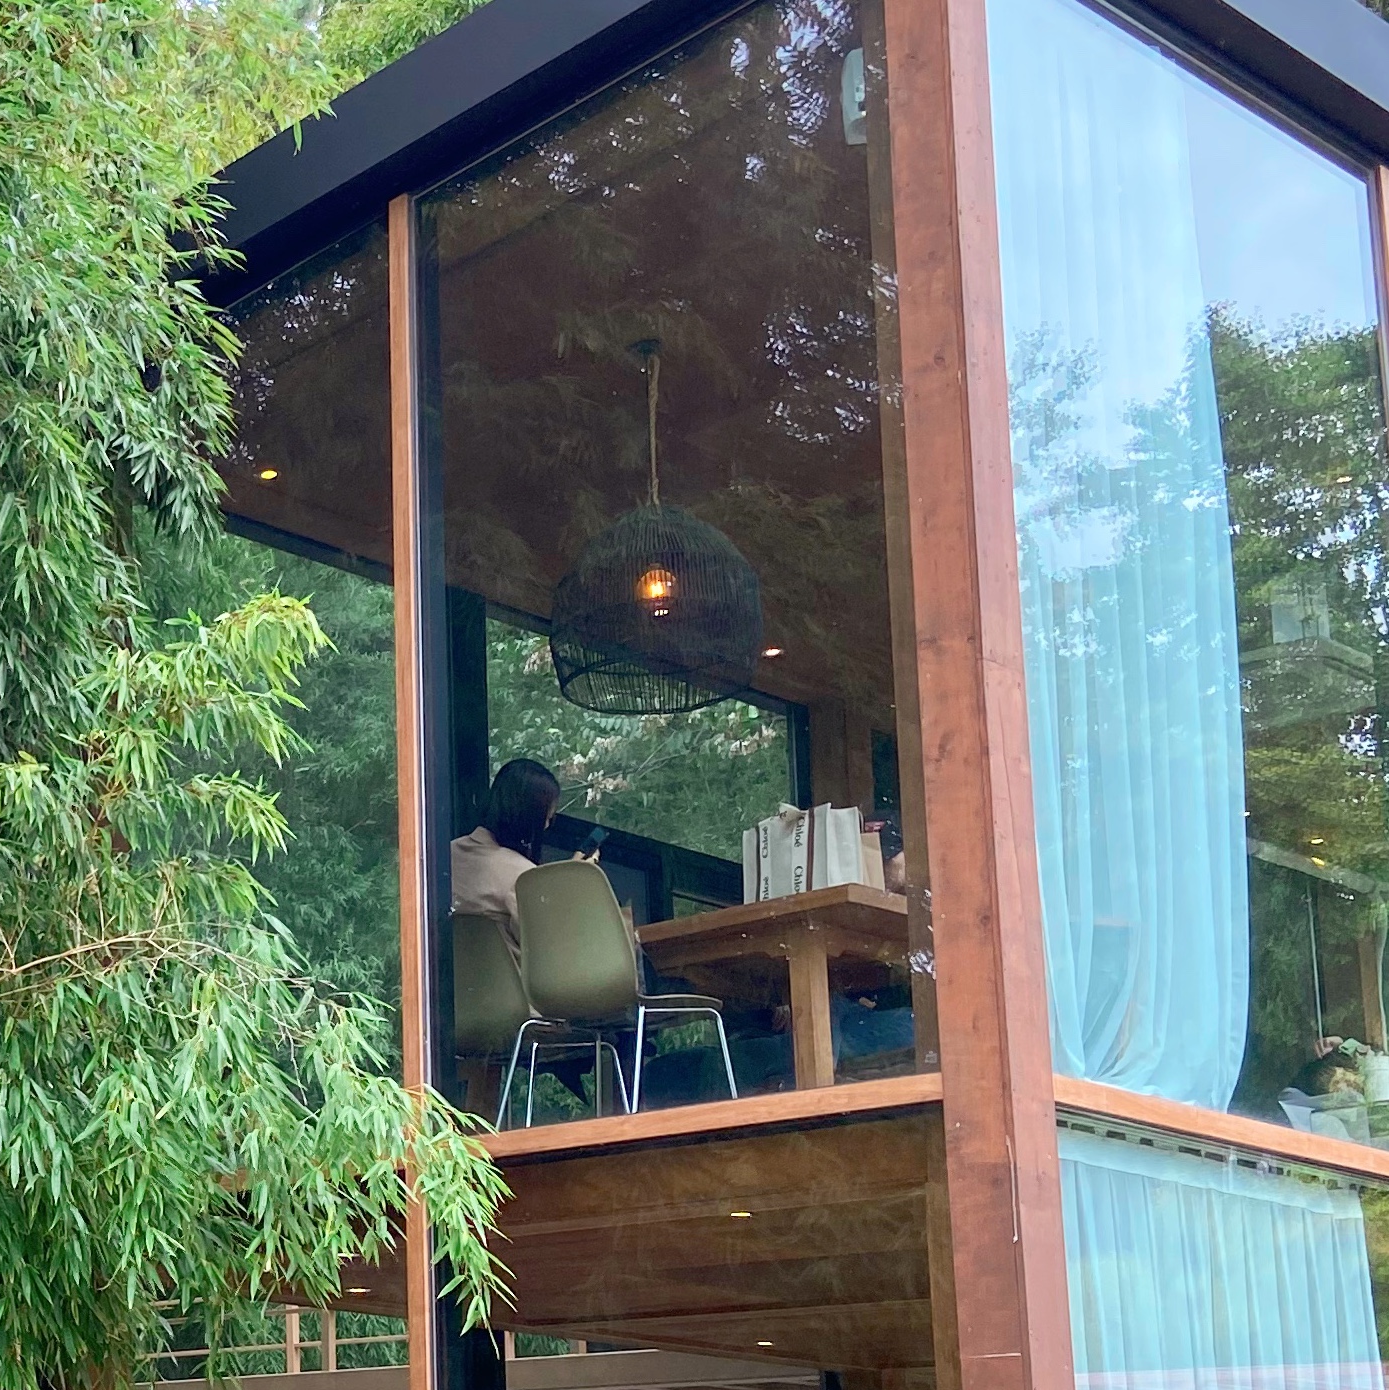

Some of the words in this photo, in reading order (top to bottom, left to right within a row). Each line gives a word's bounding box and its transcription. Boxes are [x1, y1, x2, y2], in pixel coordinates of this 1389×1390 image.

[794, 816, 805, 847] Chloé
[762, 876, 770, 900] hloé
[794, 865, 804, 894] Chlo
